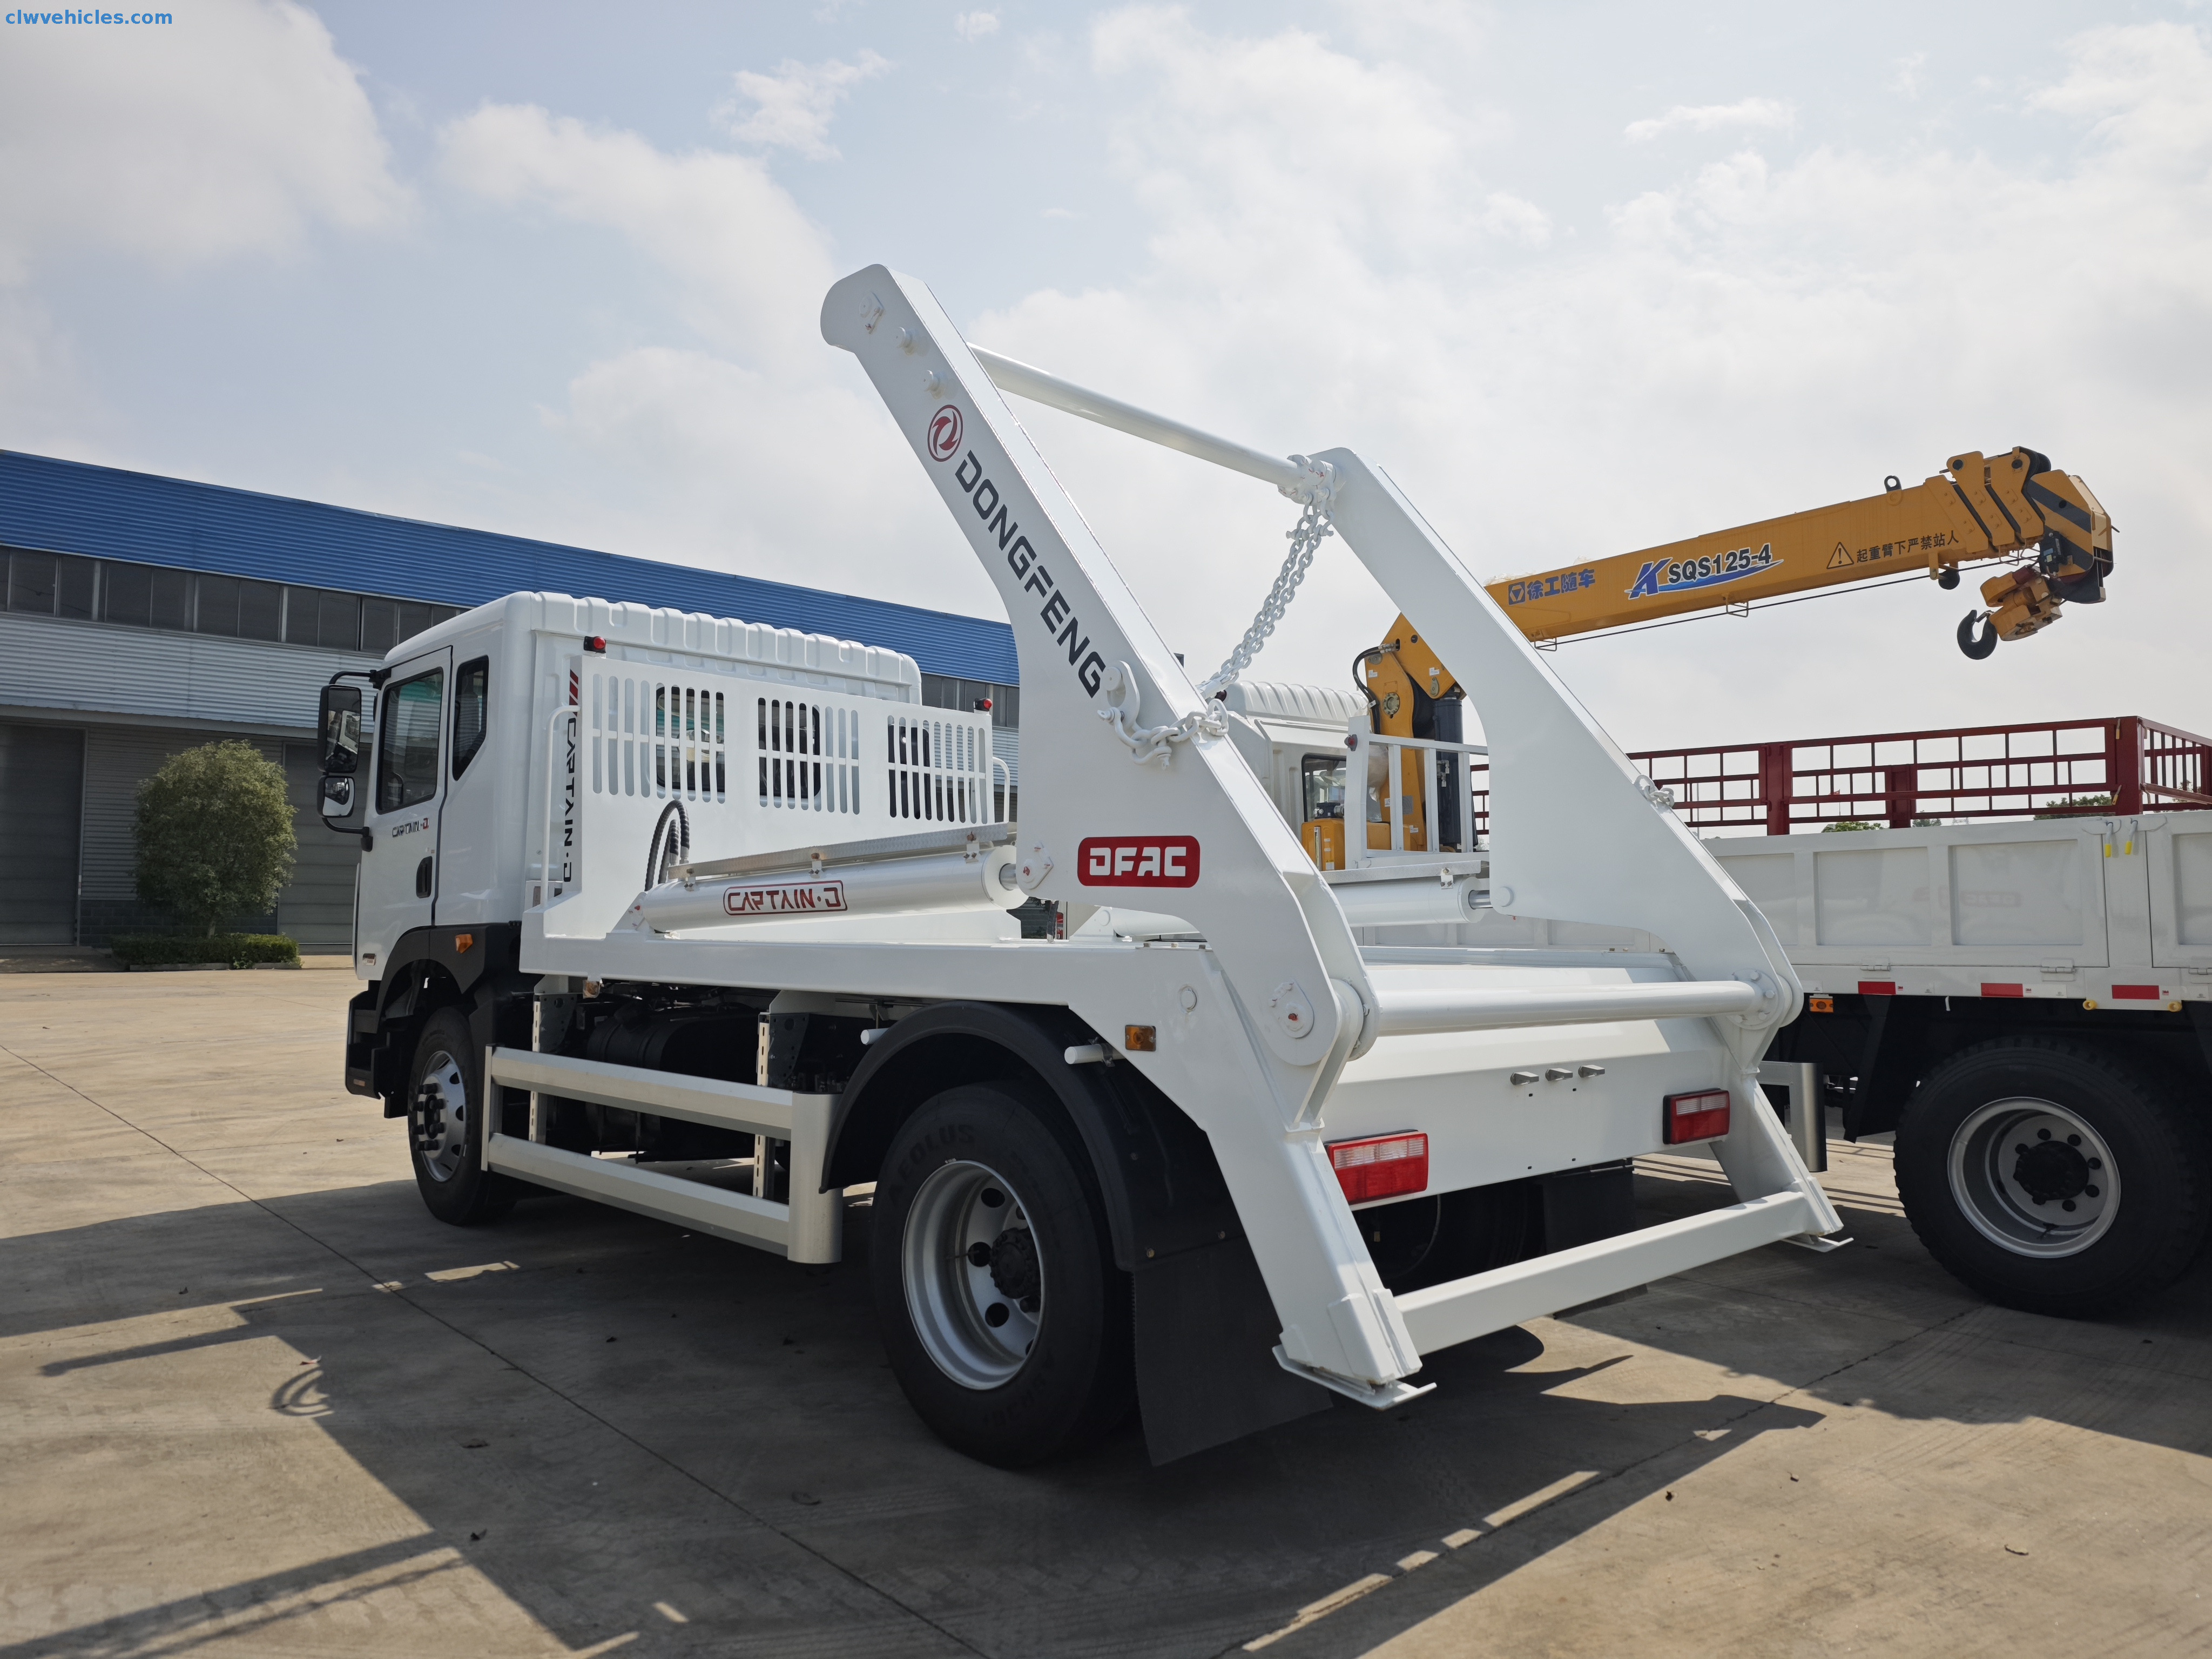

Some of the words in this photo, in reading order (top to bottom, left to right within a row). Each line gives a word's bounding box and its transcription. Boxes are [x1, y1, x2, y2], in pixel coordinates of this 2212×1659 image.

[1856, 530, 1959, 563] 起重臂下严禁站人
[954, 449, 1107, 699] DONGFENG
[1527, 569, 1596, 601] 徐工随车
[1090, 847, 1186, 878] DFAC
[887, 1124, 975, 1207] AEOLUS
